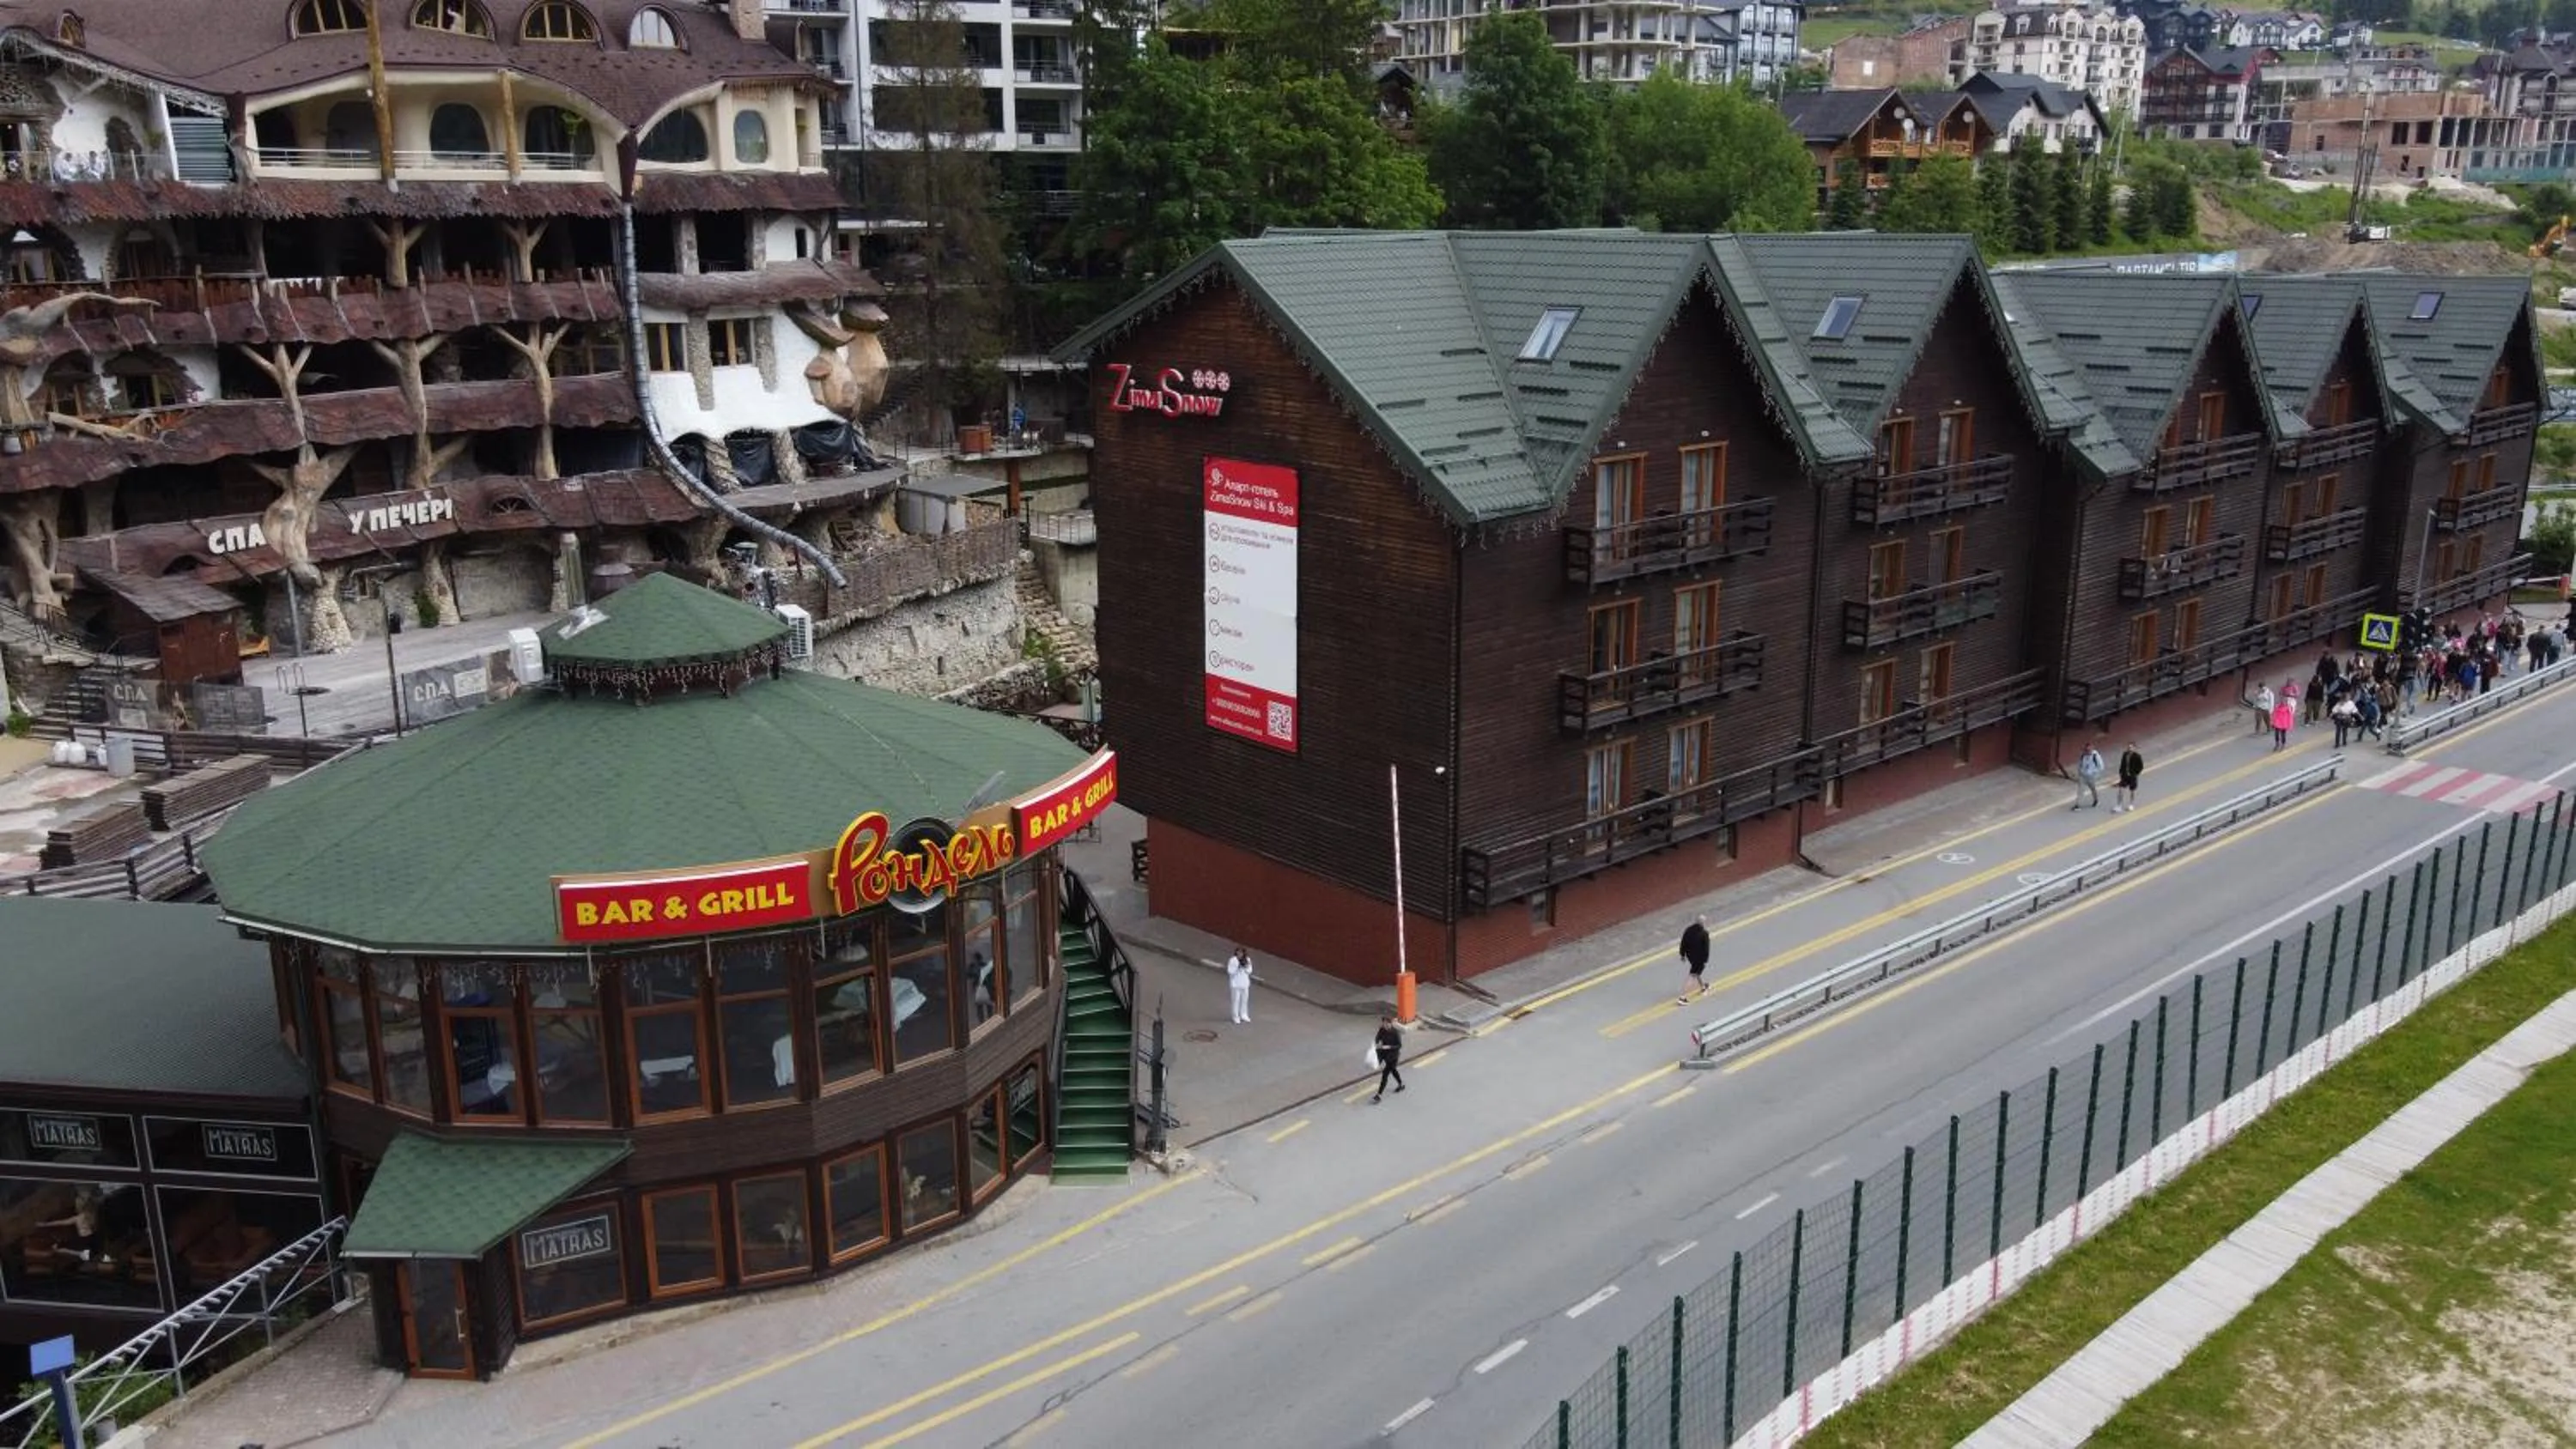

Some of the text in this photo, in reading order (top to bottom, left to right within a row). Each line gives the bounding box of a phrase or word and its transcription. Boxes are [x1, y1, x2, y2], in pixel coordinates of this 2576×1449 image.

[1253, 497, 1267, 511] Ski
[1277, 500, 1294, 517] Spa
[208, 497, 453, 555] СПА У ПЕЧЕРІ
[113, 684, 149, 701] СПА
[415, 678, 451, 702] СПА
[1030, 770, 1114, 839] BAR & GRILL
[828, 811, 1015, 917] Рондель
[576, 882, 795, 926] BAR & GRILL
[33, 1119, 96, 1146] MATRAS
[208, 1130, 272, 1155] MATRAS
[528, 1228, 605, 1264] MATRAS
